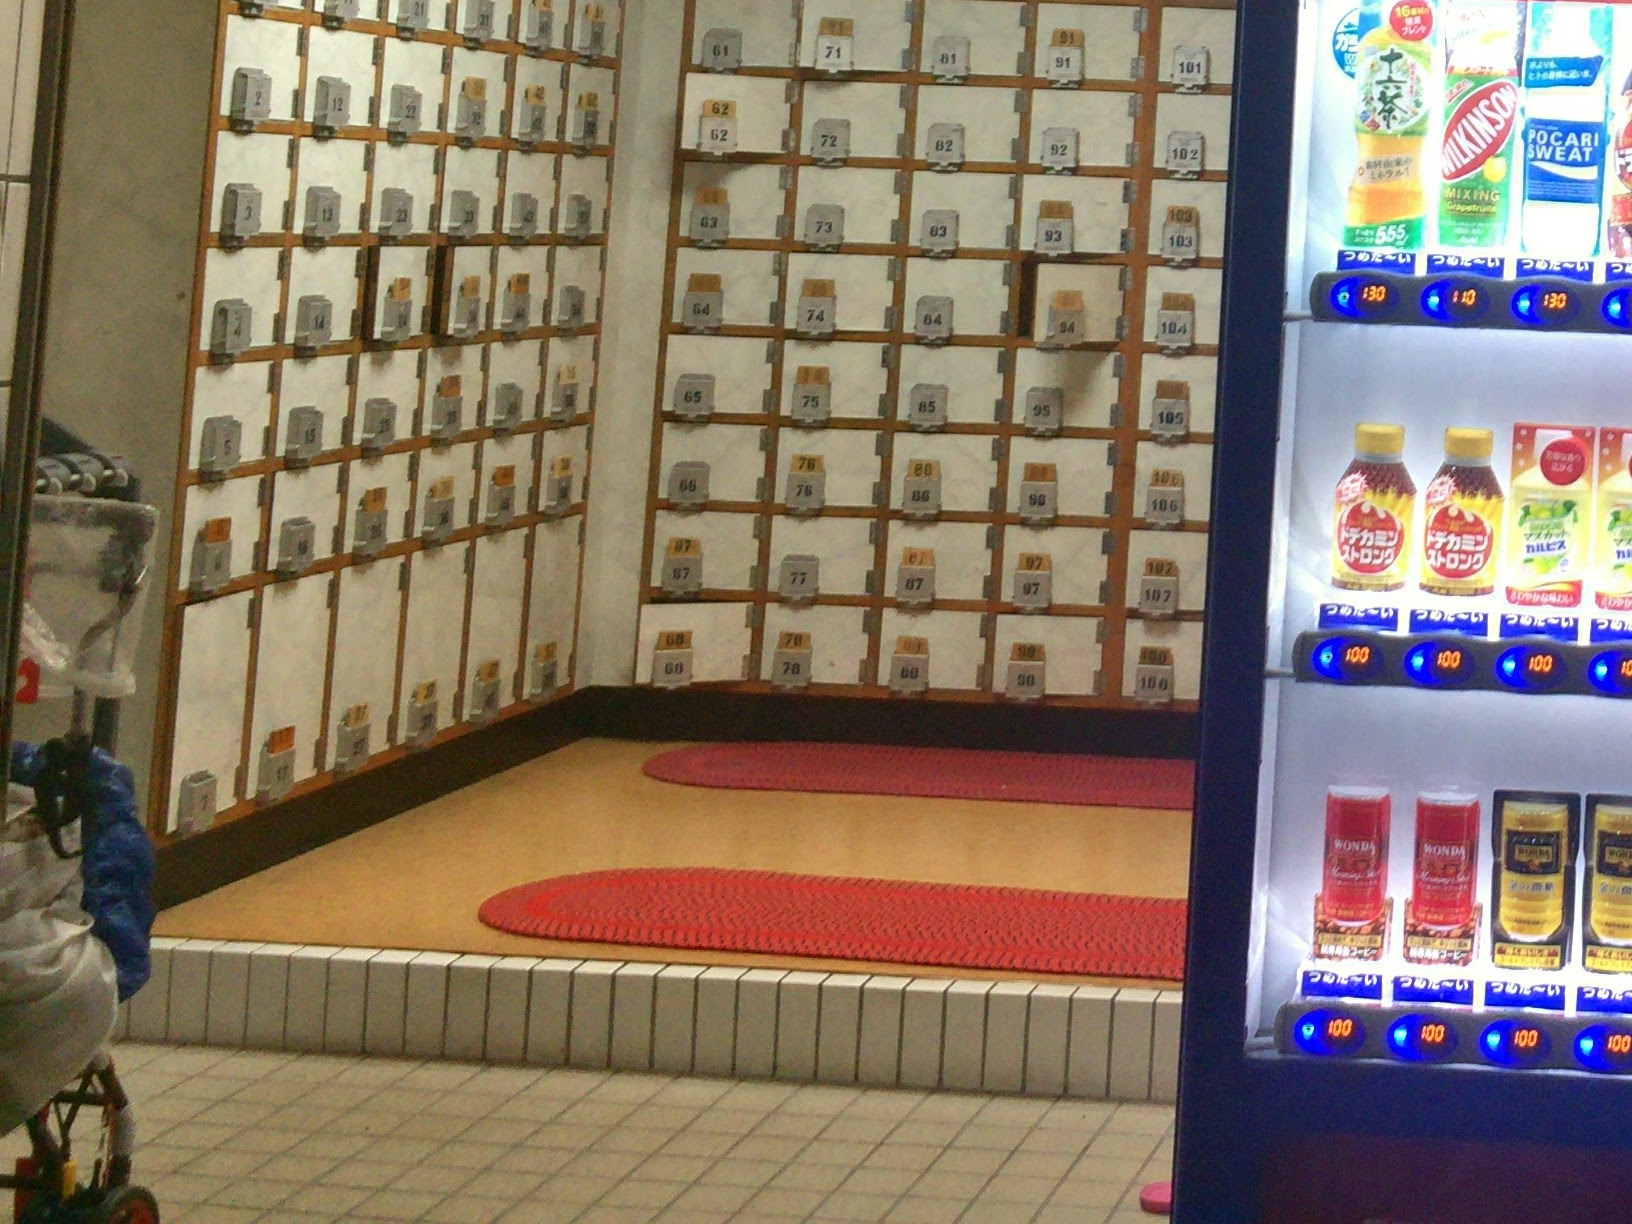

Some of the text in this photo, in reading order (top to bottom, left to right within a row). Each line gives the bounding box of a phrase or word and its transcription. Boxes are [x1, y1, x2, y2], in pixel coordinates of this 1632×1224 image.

[825, 46, 843, 59] 71
[1055, 56, 1072, 69] 91
[1178, 61, 1202, 74] 101
[1375, 46, 1410, 130] 十六茶
[331, 96, 344, 113] 12
[711, 102, 730, 116] 62
[710, 128, 728, 142] 62
[1441, 84, 1518, 177] WILKINSON
[1527, 128, 1600, 148] POCARI
[820, 134, 838, 148] 72
[1050, 143, 1069, 157] 92
[1171, 147, 1199, 161] 102
[1526, 145, 1594, 163] SWEAT
[1445, 188, 1501, 202] MIXING
[1169, 209, 1193, 223] 103
[815, 221, 834, 234] 73
[1044, 230, 1063, 243] 93
[1168, 235, 1193, 248] 103
[1362, 285, 1386, 302] 130
[1452, 289, 1476, 305] 110
[1543, 293, 1567, 309] 130
[806, 309, 826, 323] 74
[1160, 321, 1188, 335] 104
[801, 395, 820, 409] 75
[1340, 526, 1399, 547] ドデカミン
[1426, 528, 1489, 551] ドデカミン
[1525, 540, 1567, 554] カルピス
[1025, 555, 1043, 568] 97
[1340, 545, 1396, 565] ストロング
[1426, 549, 1485, 571] ストロング
[790, 572, 808, 585] 77
[1022, 582, 1040, 596] 97
[1144, 589, 1171, 603] 107
[1345, 646, 1370, 663] 100
[1436, 651, 1461, 668] 100
[1528, 654, 1553, 672] 100
[1334, 839, 1377, 856] WONDA
[1423, 842, 1466, 860] WONDA
[1327, 1019, 1353, 1037] 100
[1420, 1024, 1445, 1043] 100
[1513, 1029, 1538, 1047] 100
[1606, 1035, 1632, 1053] 100
